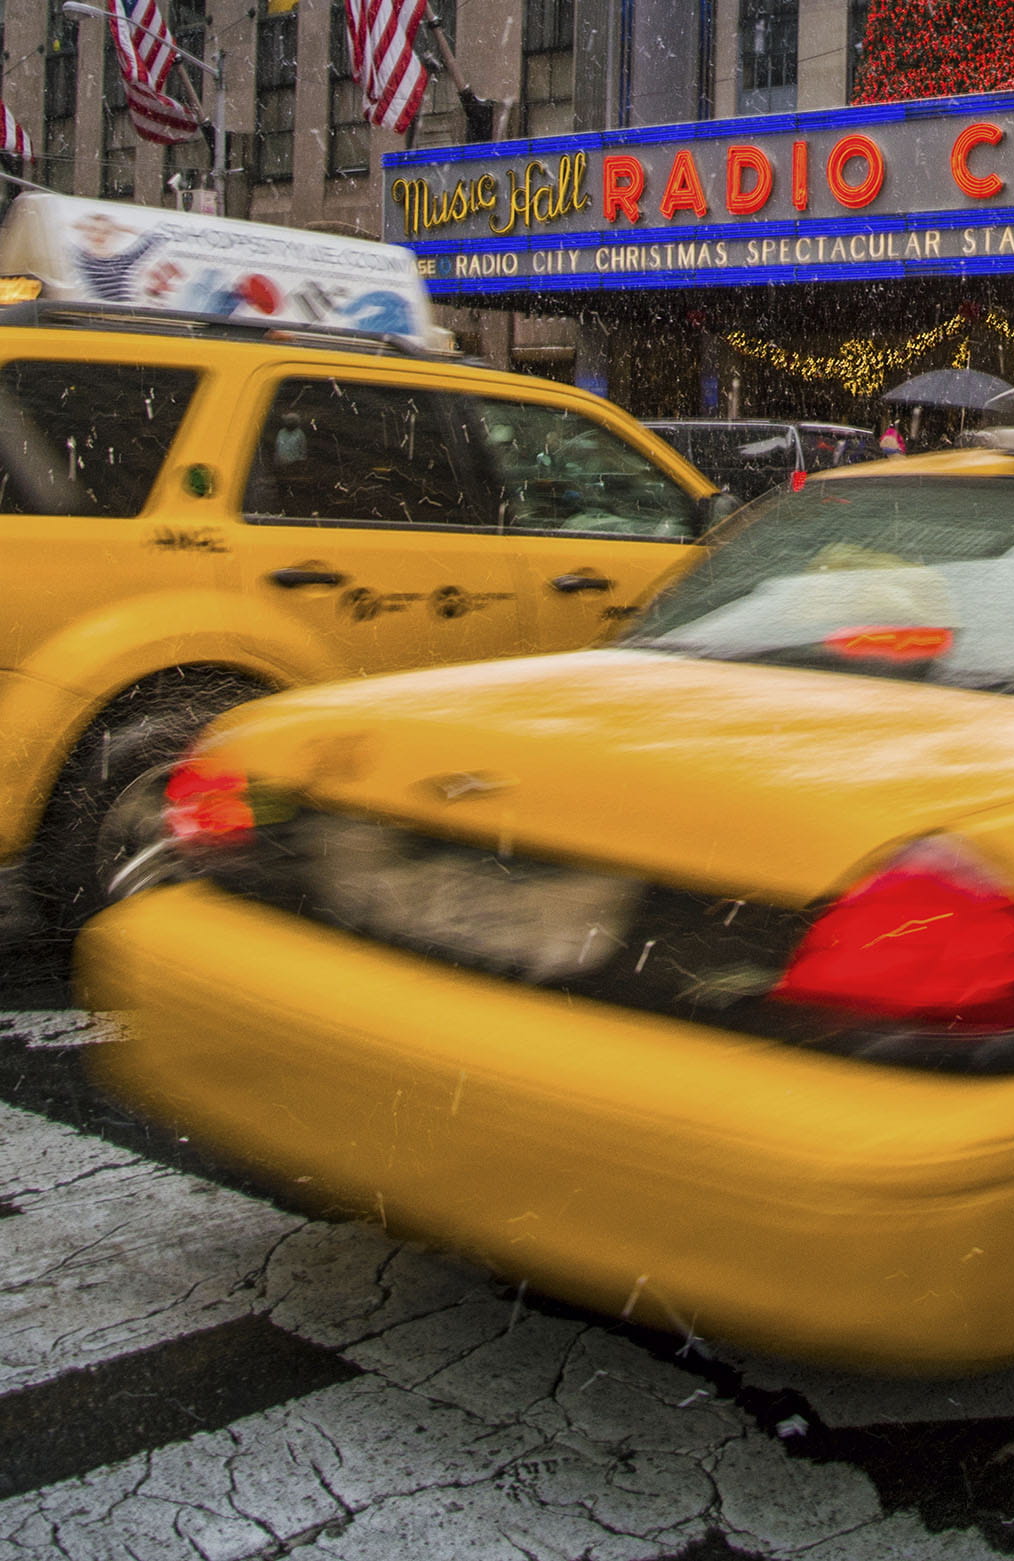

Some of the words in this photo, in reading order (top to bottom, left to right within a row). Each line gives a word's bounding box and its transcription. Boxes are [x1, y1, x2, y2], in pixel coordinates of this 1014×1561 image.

[391, 175, 498, 236] Music
[489, 151, 592, 235] Hall
[603, 133, 886, 223] RADIO
[455, 252, 518, 276] RADIO
[532, 249, 581, 274] CITY
[595, 241, 728, 271] CHRISTMAS
[747, 230, 941, 266] SPECTACULAR
